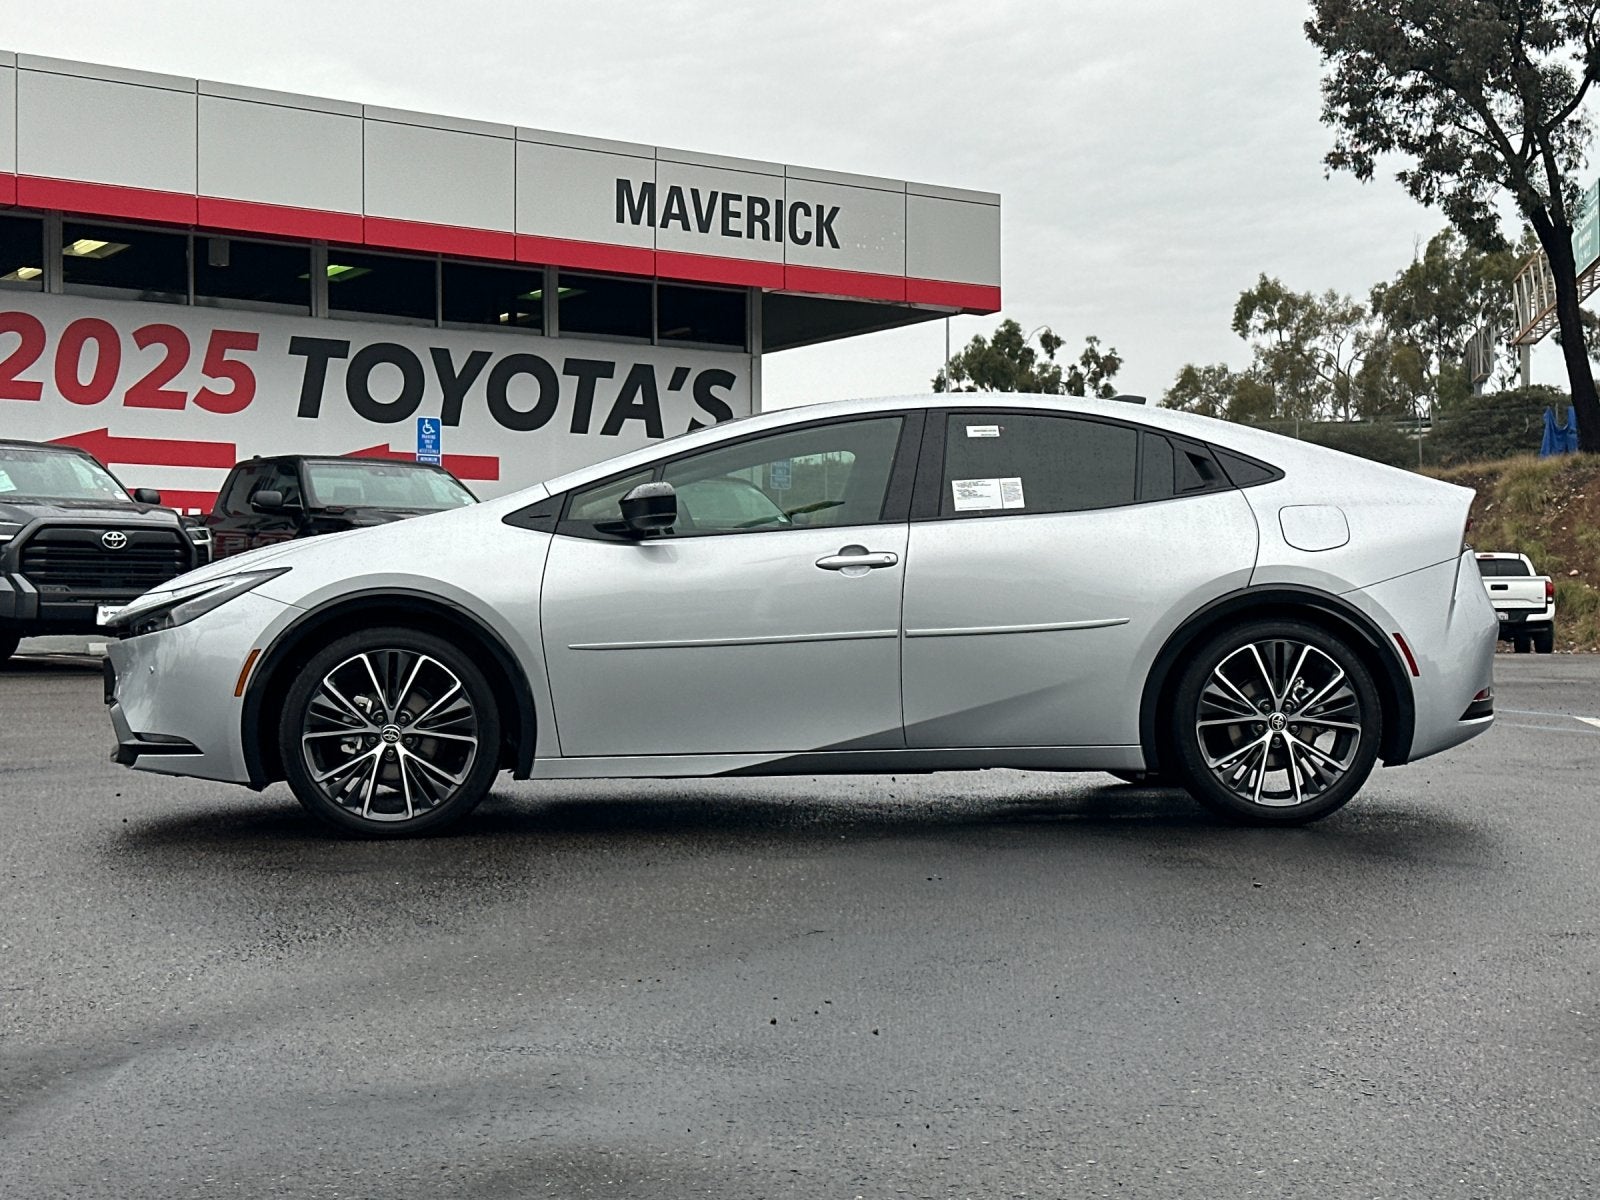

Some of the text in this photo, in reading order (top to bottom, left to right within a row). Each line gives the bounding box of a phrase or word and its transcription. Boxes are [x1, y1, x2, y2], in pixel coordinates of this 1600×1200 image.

[616, 178, 840, 249] MAVERICK
[0, 311, 737, 439] 2025 TOYOTA'S
